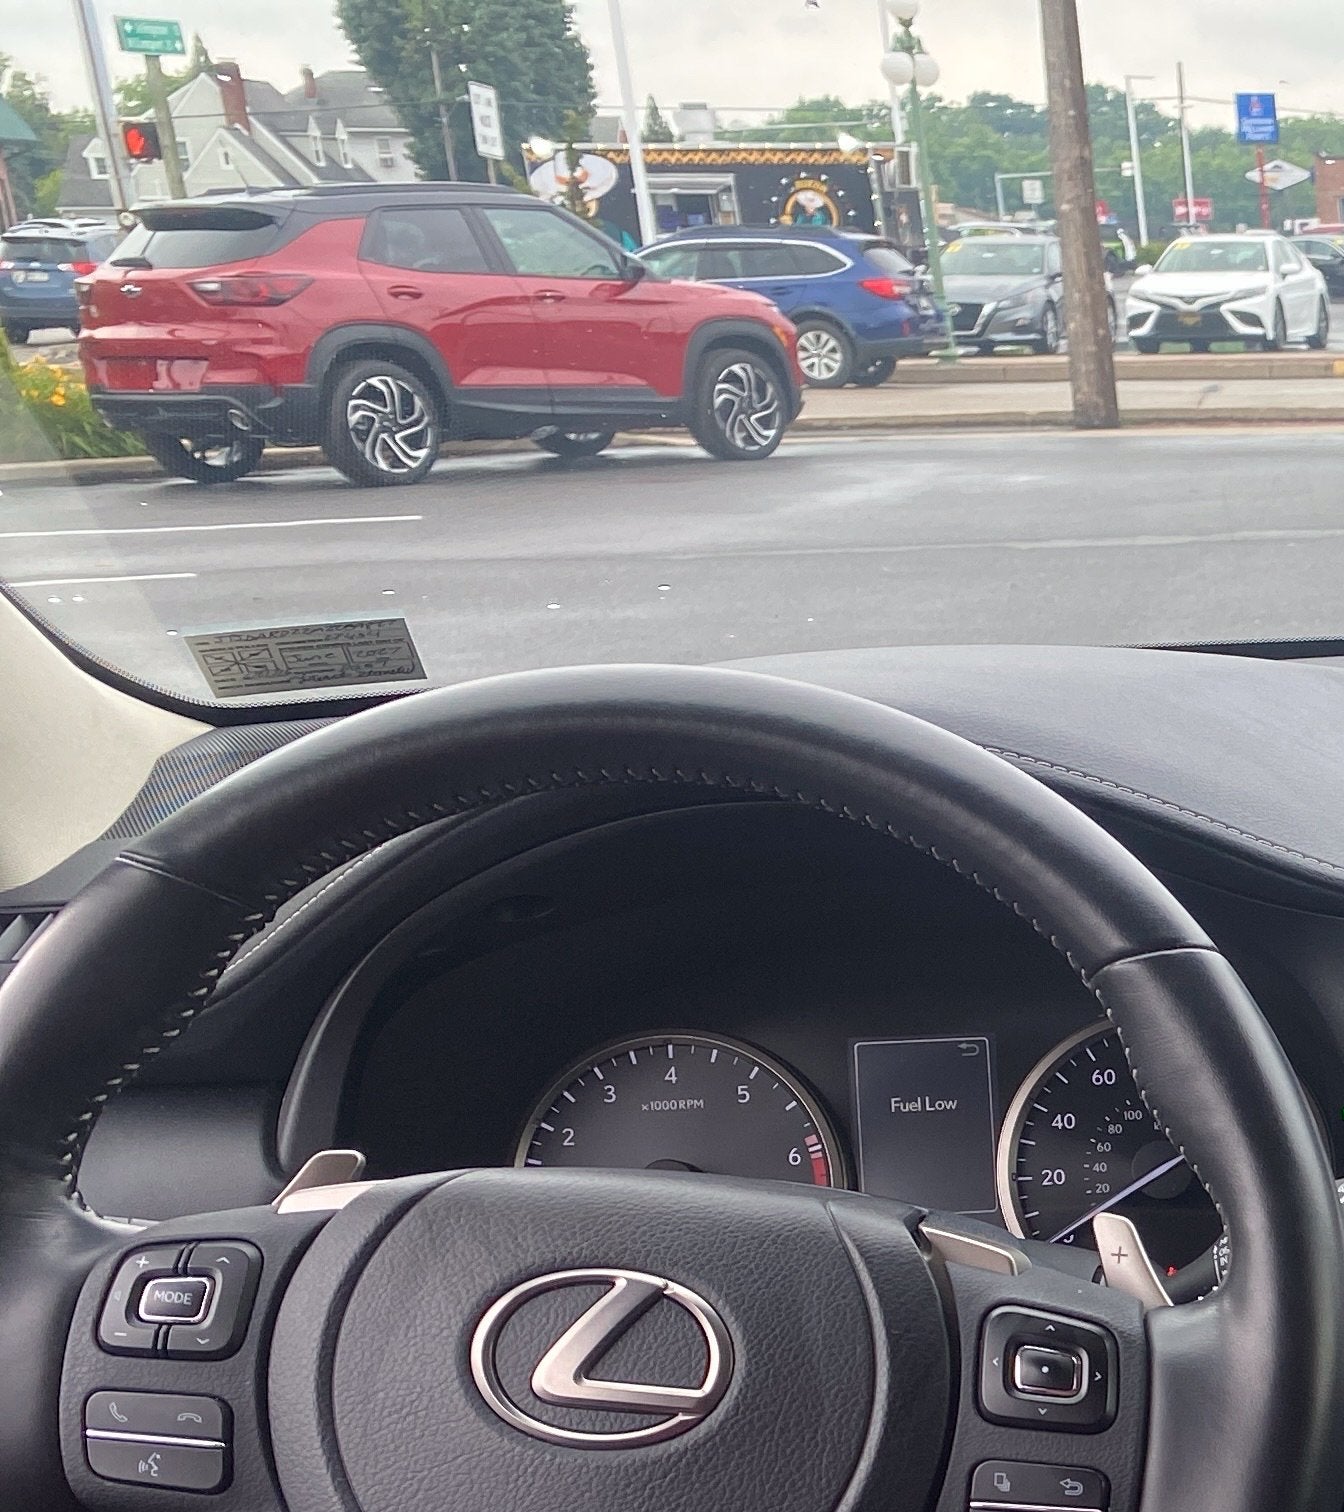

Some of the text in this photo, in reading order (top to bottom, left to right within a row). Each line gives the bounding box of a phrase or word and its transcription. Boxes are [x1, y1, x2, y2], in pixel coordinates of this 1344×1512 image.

[664, 1066, 678, 1084] 4
[1091, 1068, 1116, 1086] 60
[603, 1085, 617, 1103] 3
[737, 1085, 750, 1104] 5
[890, 1097, 958, 1113] Fuel Low
[1051, 1113, 1076, 1130] 40
[1123, 1110, 1143, 1121] 100
[562, 1128, 576, 1146] 2
[1107, 1124, 1123, 1135] 80
[1096, 1142, 1112, 1153] 60
[788, 1148, 801, 1165] 6
[1092, 1162, 1107, 1173] 40
[1041, 1169, 1066, 1186] 20
[1095, 1183, 1110, 1194] 20
[153, 1289, 193, 1305] MODE
